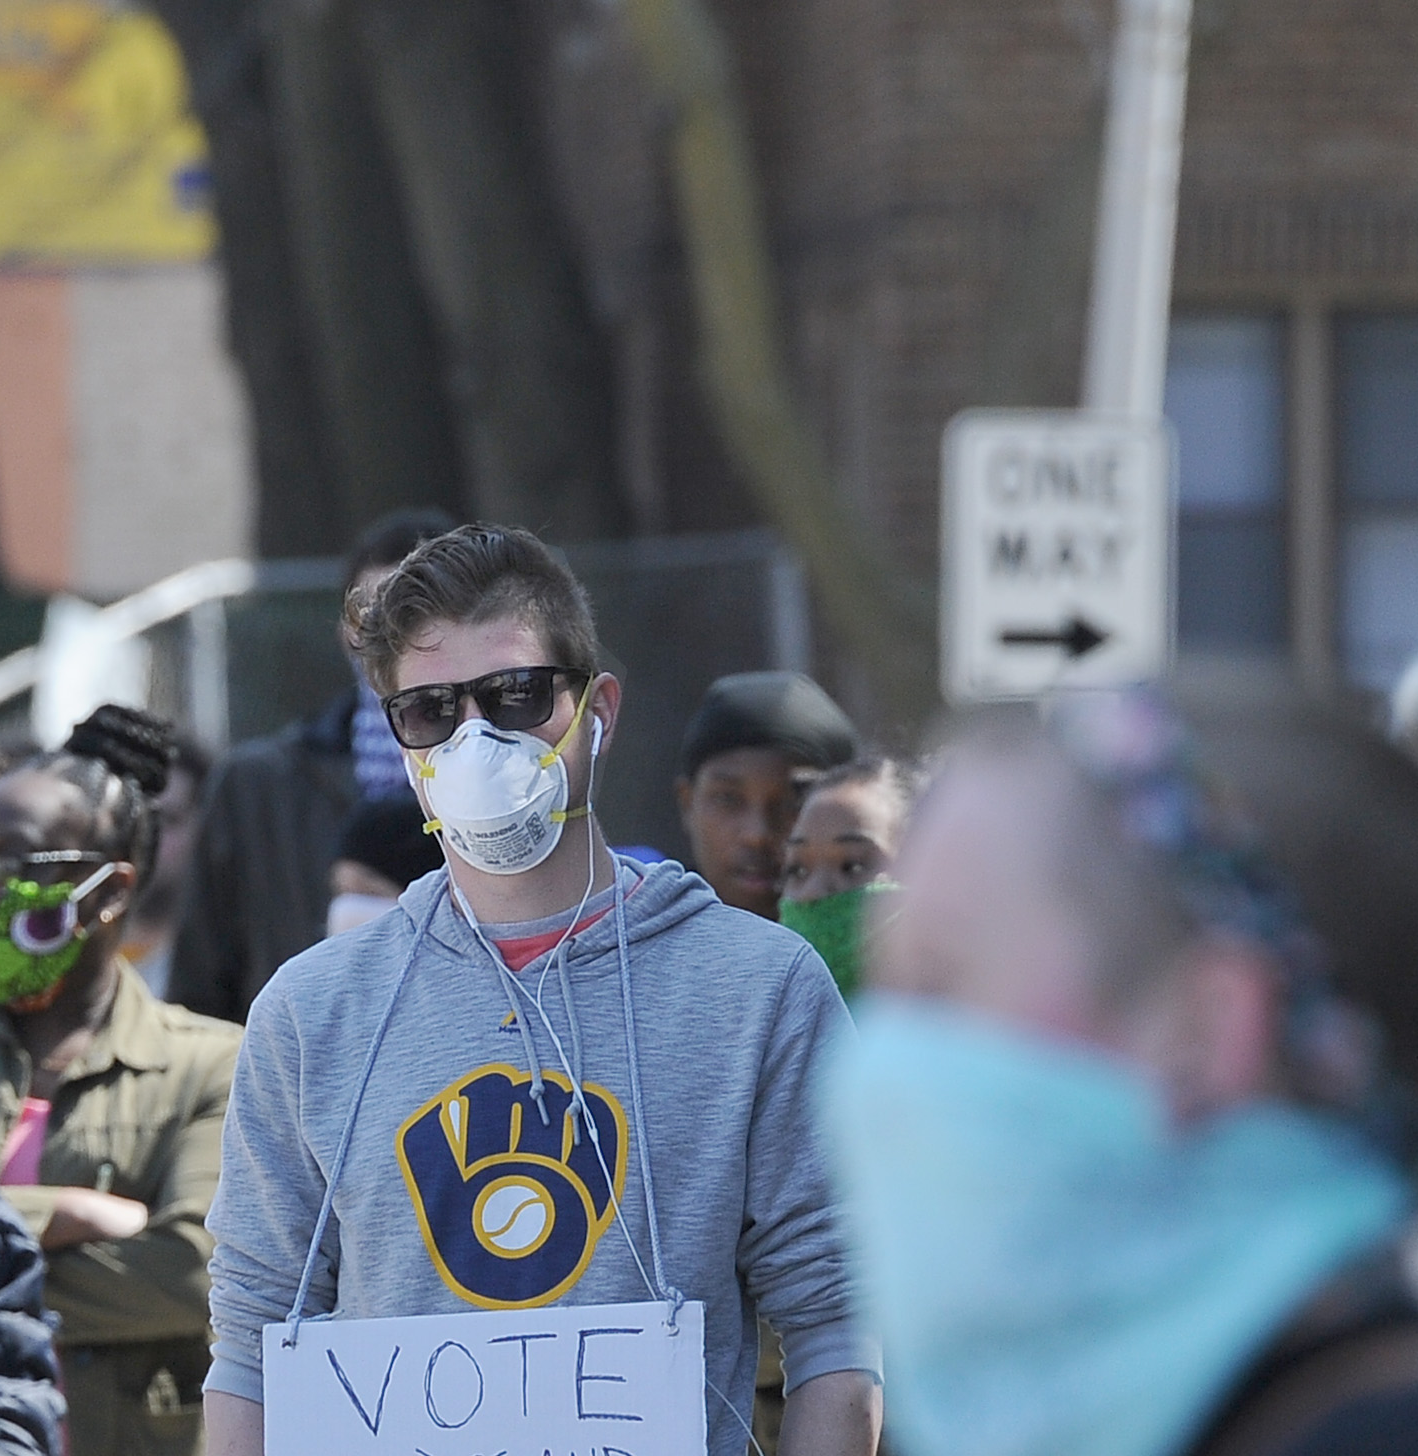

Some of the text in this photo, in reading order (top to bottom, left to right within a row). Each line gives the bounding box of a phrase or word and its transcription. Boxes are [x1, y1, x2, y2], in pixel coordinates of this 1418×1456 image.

[985, 450, 1121, 505] ONE
[985, 530, 1123, 580] WAY
[327, 1328, 644, 1436] VOTE
